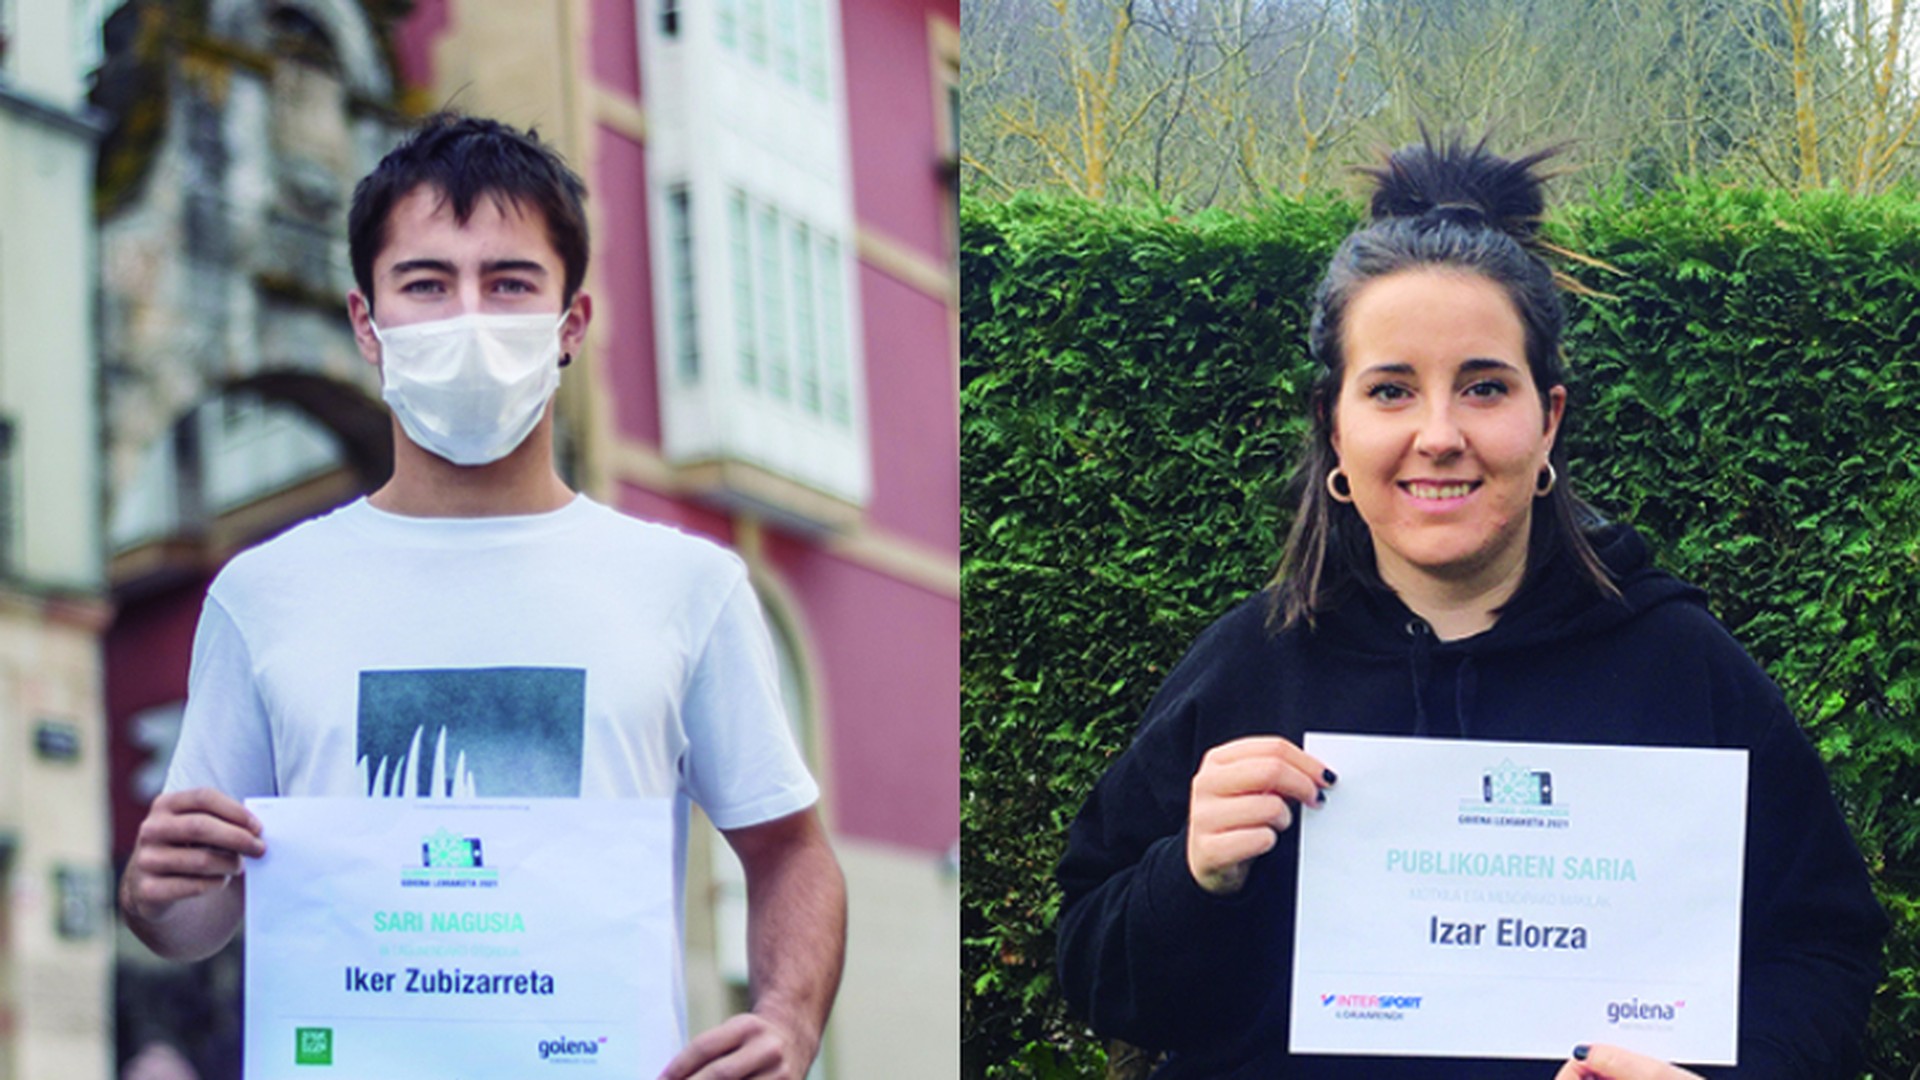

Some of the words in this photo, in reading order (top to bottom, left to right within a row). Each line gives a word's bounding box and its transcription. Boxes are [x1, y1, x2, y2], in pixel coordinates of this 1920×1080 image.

[1387, 849, 1554, 878] PUBLIKOAREN
[1563, 857, 1637, 881] SARIA
[374, 911, 423, 932] SARI
[430, 911, 526, 933] NAGUSIA
[1430, 915, 1486, 945] Izar
[1497, 917, 1587, 949] Elorza
[345, 966, 396, 992] Iker
[405, 967, 554, 995] Zubizarreta
[1336, 994, 1422, 1009] INTERSPORT
[1607, 997, 1675, 1024] goiena
[538, 1035, 598, 1059] goiena
